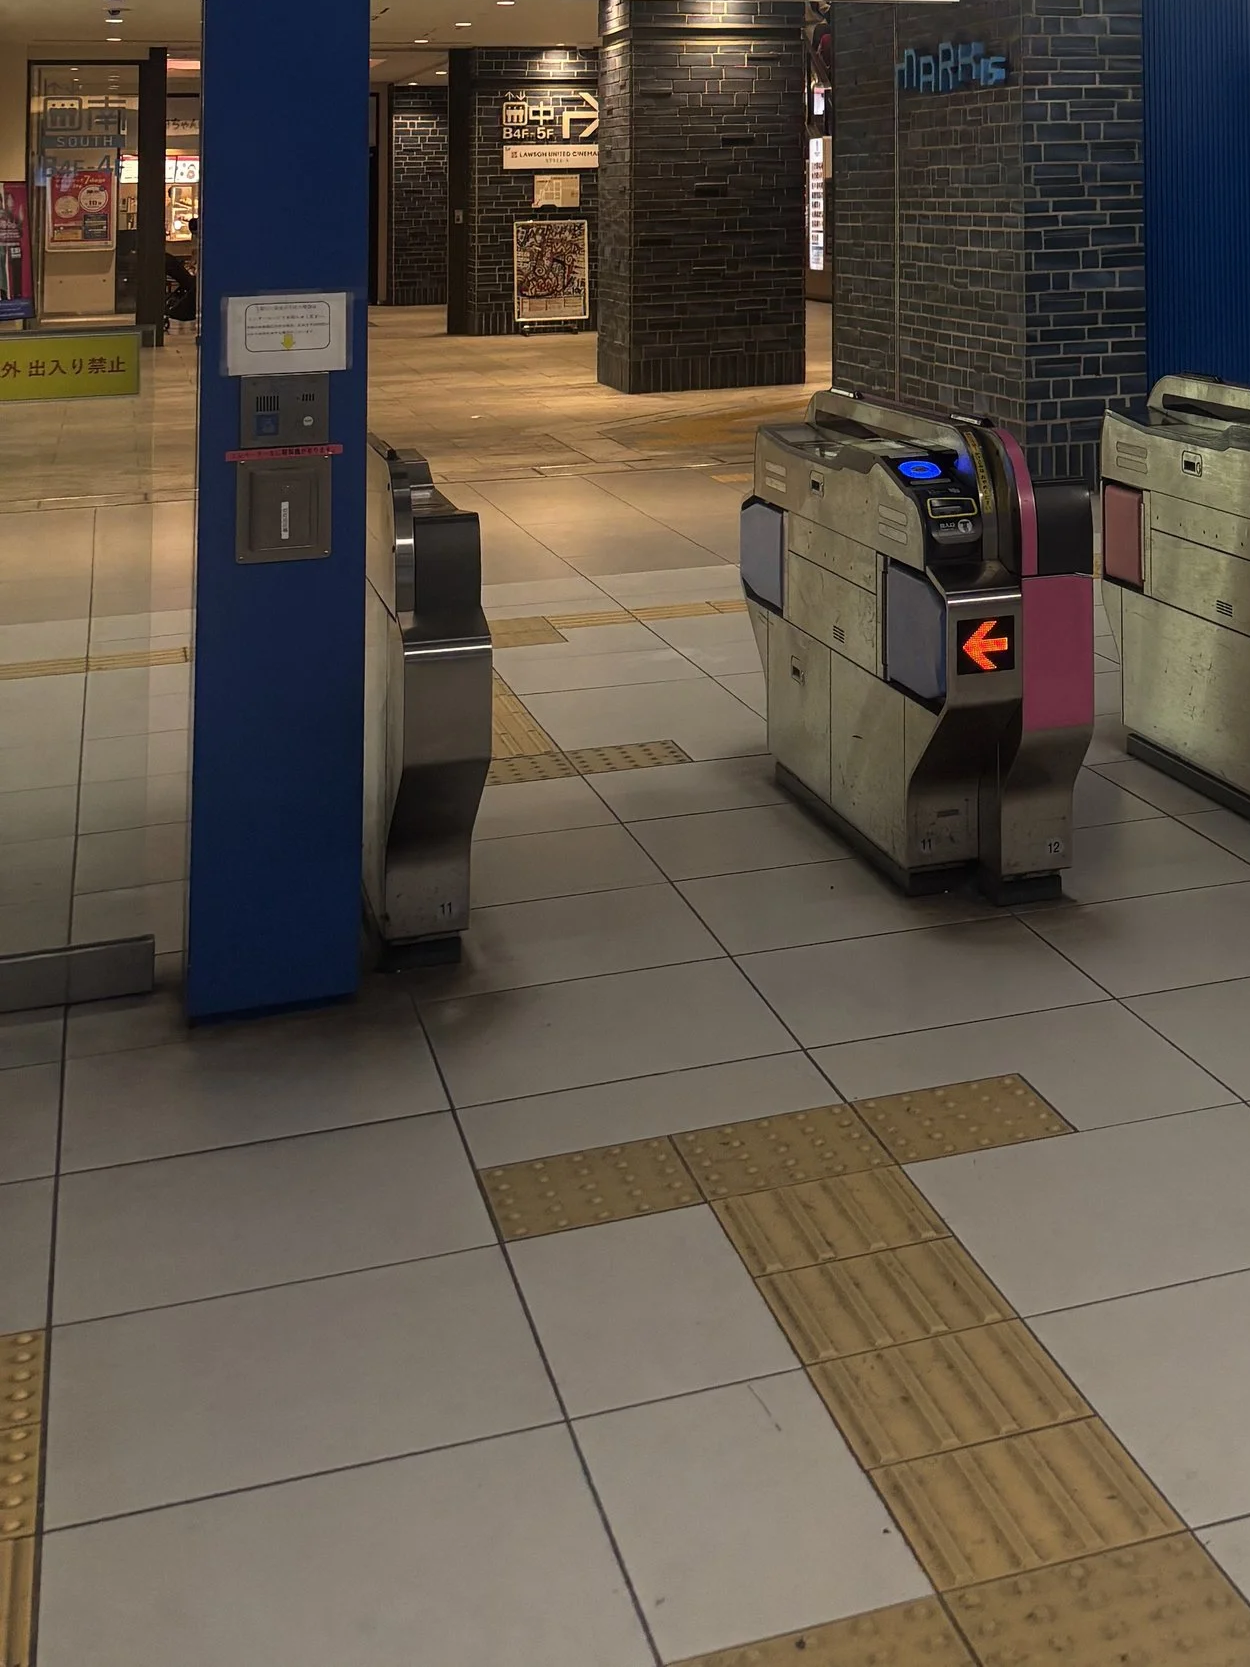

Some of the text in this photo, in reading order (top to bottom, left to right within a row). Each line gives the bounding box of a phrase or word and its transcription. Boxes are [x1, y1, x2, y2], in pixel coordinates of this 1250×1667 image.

[529, 101, 554, 126] 中
[503, 127, 554, 140] B4F-5F
[56, 137, 113, 147] SOUTH
[1, 355, 126, 379] 外 出入り禁止
[920, 838, 932, 851] 11
[1048, 841, 1060, 854] 12
[440, 901, 452, 916] 11
